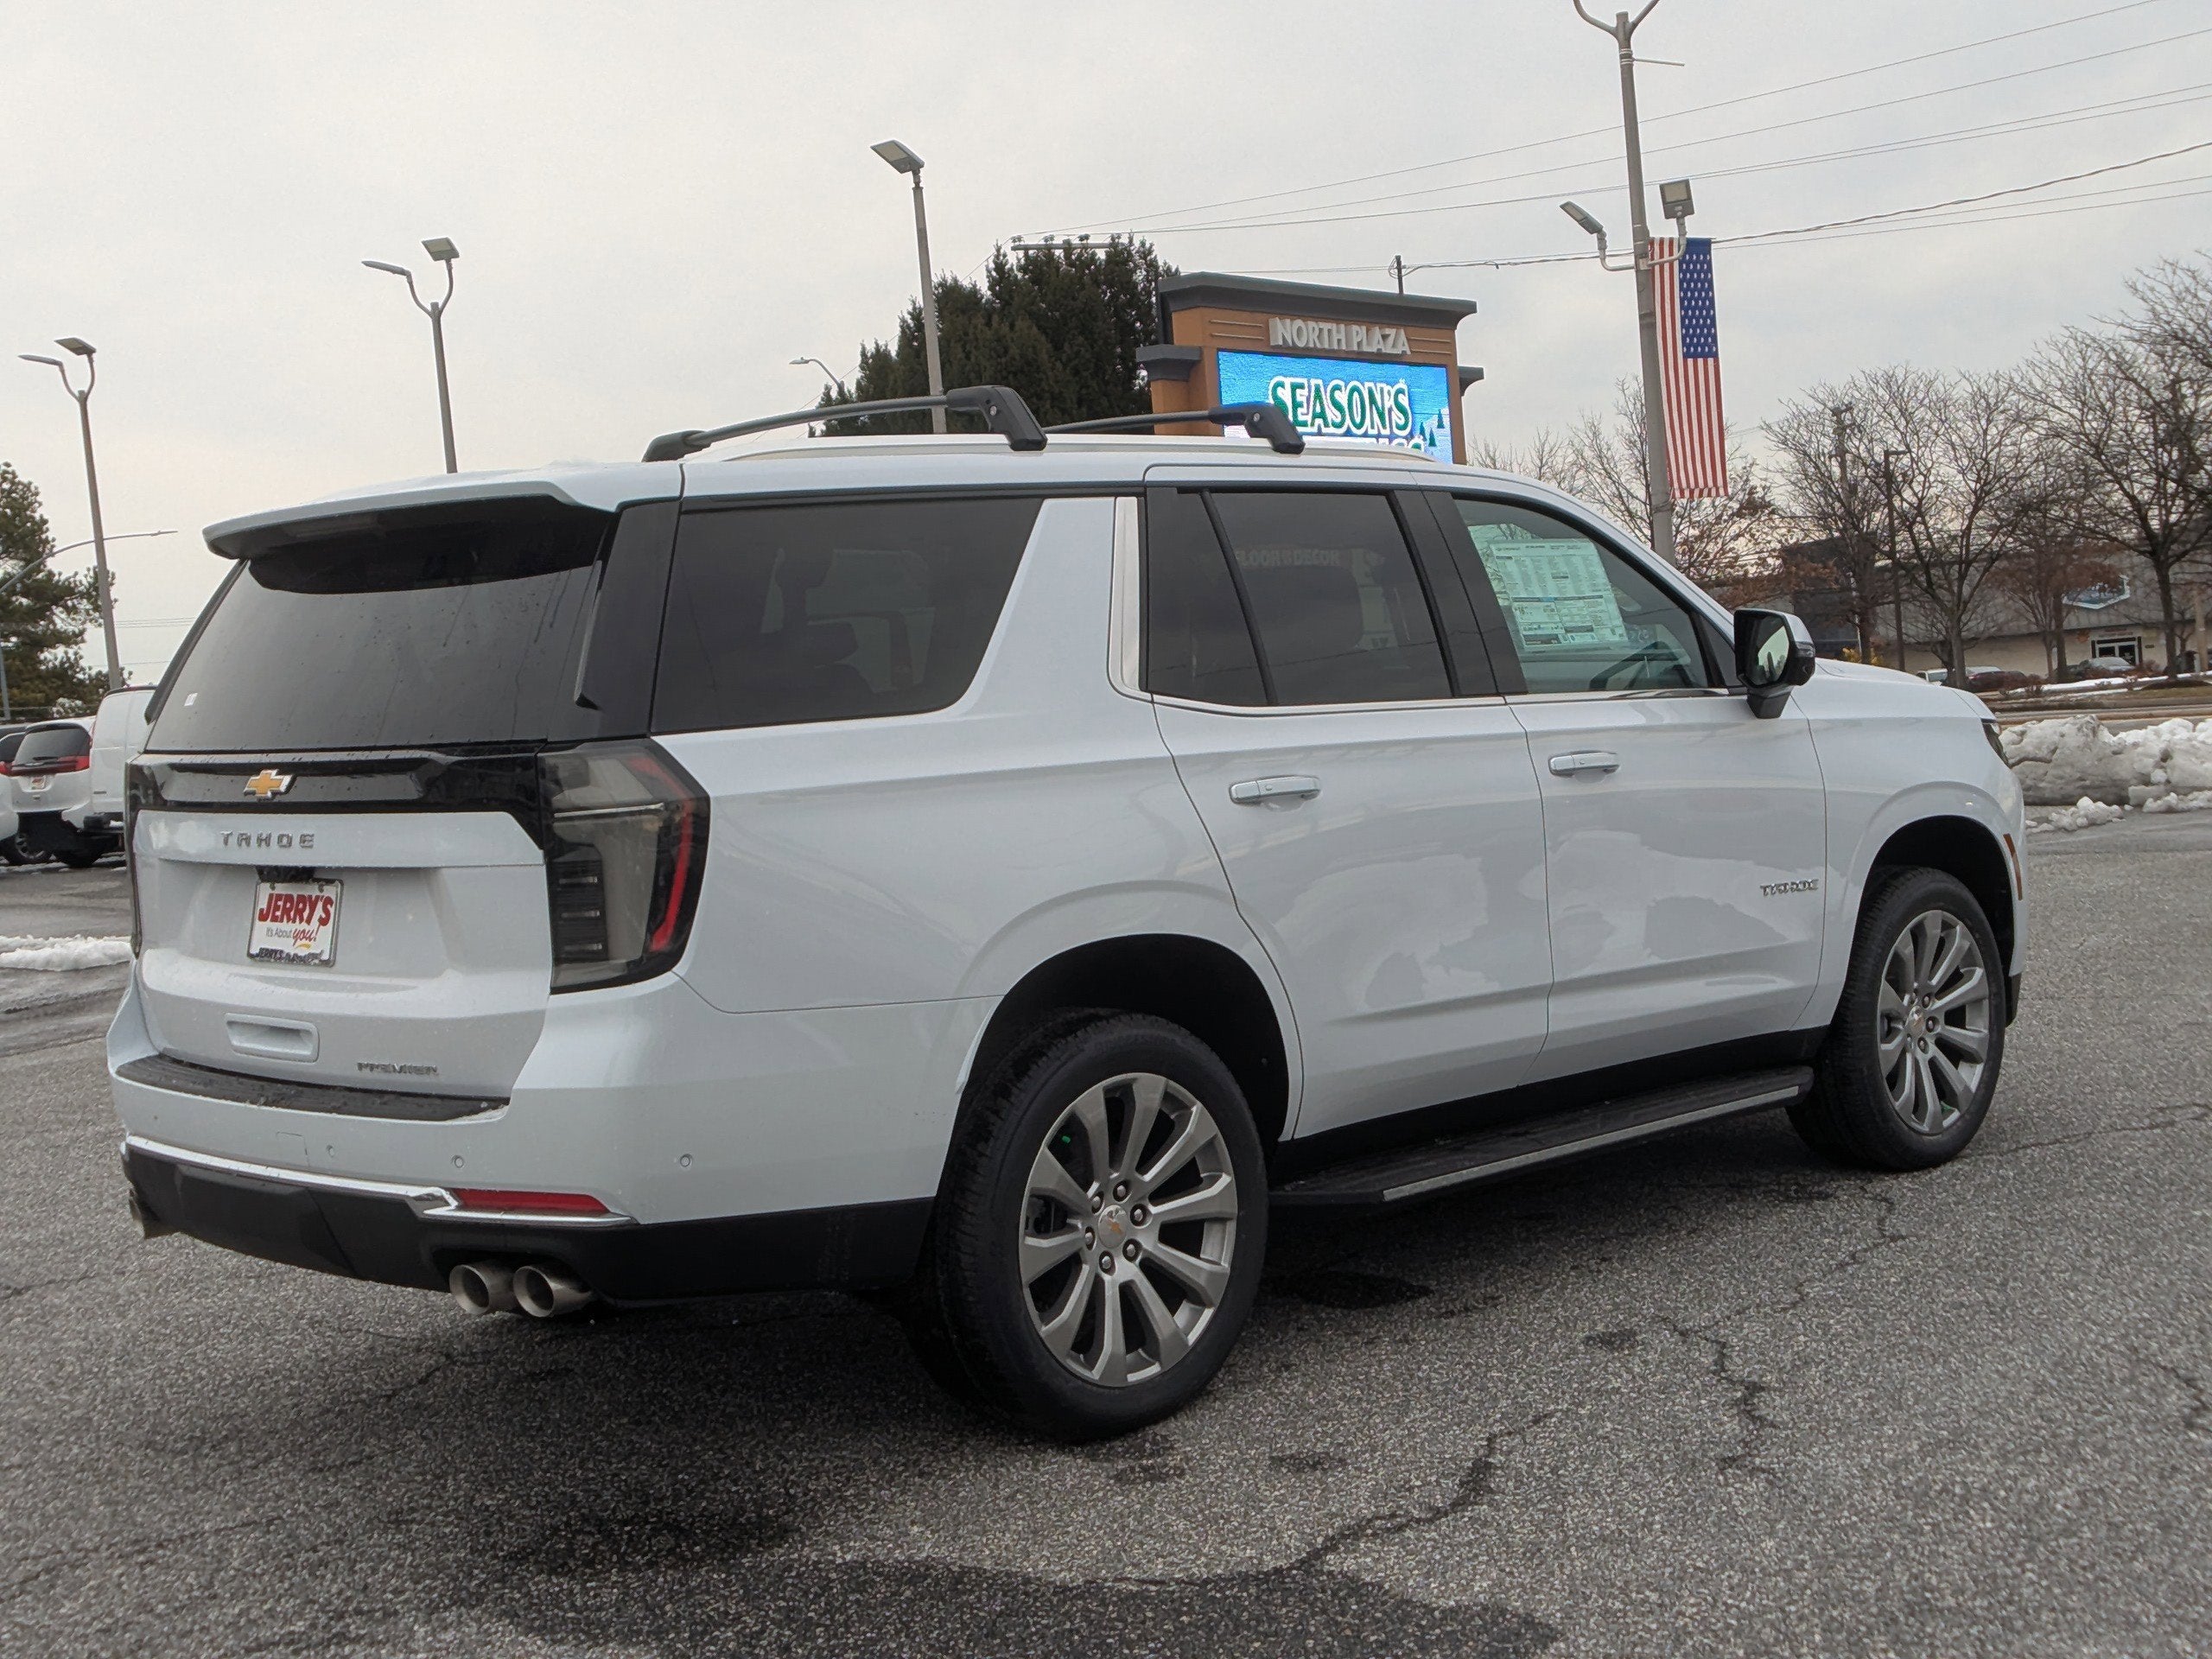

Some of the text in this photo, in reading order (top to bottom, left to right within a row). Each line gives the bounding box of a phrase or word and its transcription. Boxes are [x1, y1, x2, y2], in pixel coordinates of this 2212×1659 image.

[1268, 317, 1411, 355] NORTH PLAZA
[1269, 378, 1412, 434] SEASON'S
[219, 830, 315, 849] TAHOE
[1760, 879, 1819, 896] TAHOE
[257, 893, 334, 926] JERRY'S
[265, 924, 321, 947] It's About you!
[357, 1062, 439, 1076] PREMIER
